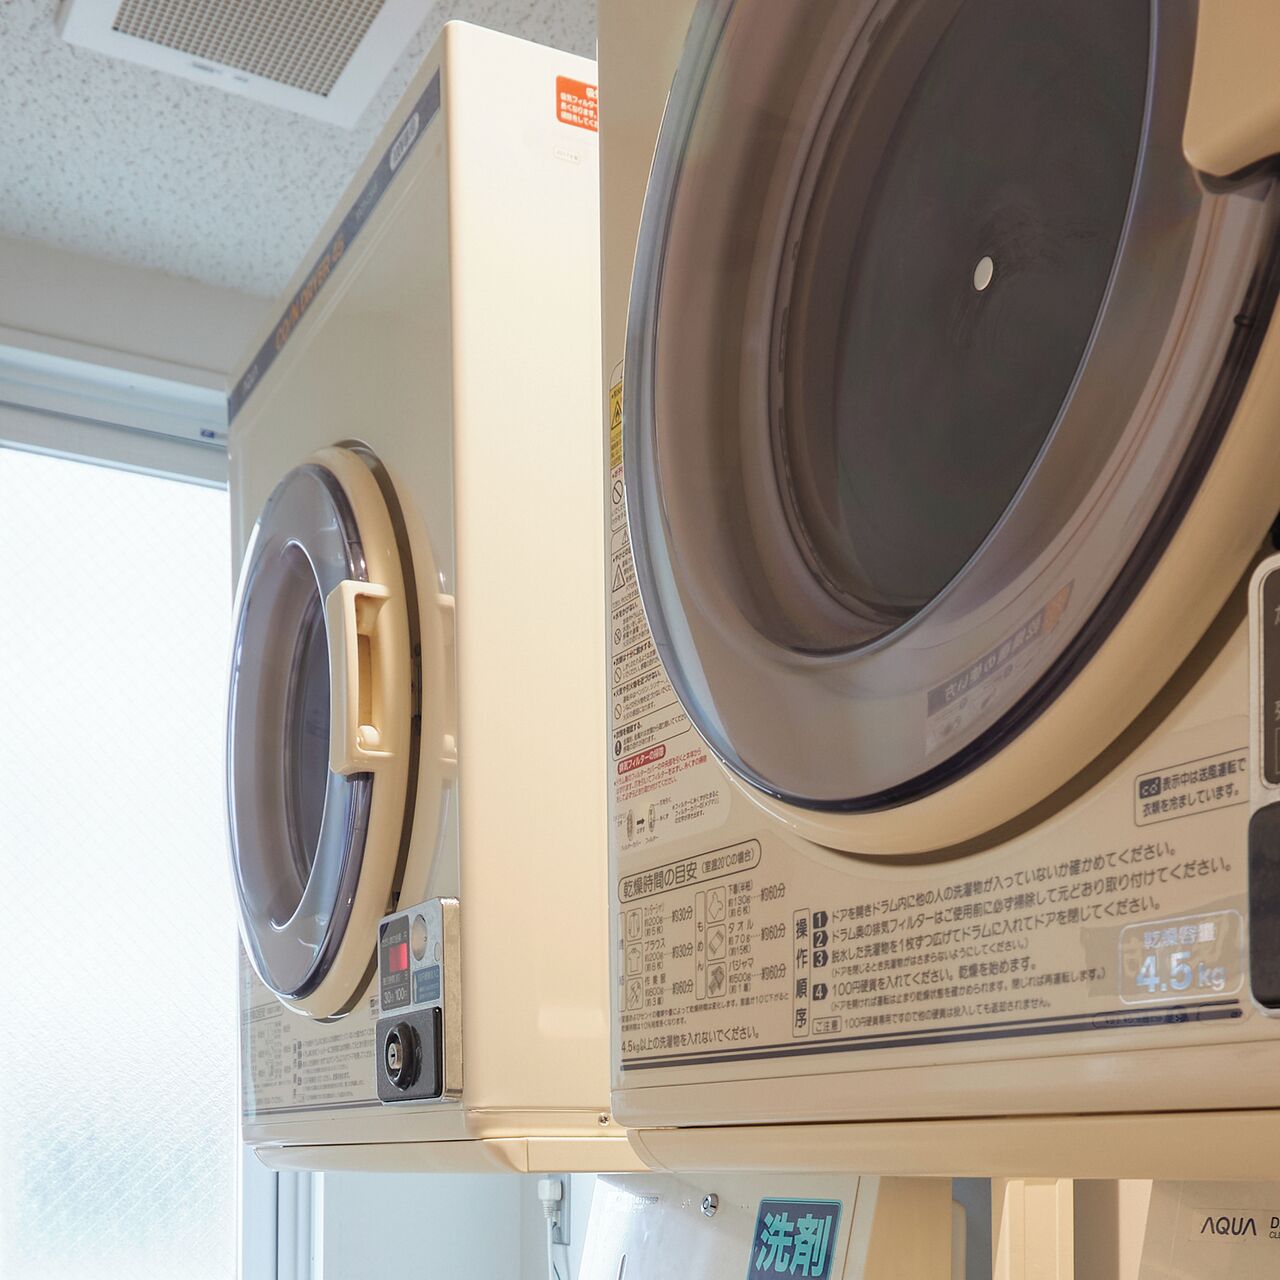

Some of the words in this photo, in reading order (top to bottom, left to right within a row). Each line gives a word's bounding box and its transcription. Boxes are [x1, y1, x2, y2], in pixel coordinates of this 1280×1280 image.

[1143, 783, 1241, 817] 衣類を冷ましています。
[623, 860, 698, 900] 乾燥時間の目安
[814, 912, 823, 927] 1
[814, 932, 823, 947] 2
[1143, 922, 1218, 950] 乾燥容量
[814, 951, 824, 967] 3
[794, 917, 809, 1030] 操作順序
[1136, 952, 1194, 993] 4.5
[1197, 962, 1227, 991] kg
[814, 984, 824, 1000] 4
[815, 1018, 839, 1034] ご注意
[1200, 1216, 1257, 1236] AQUA
[755, 1212, 834, 1278] 洗剤
